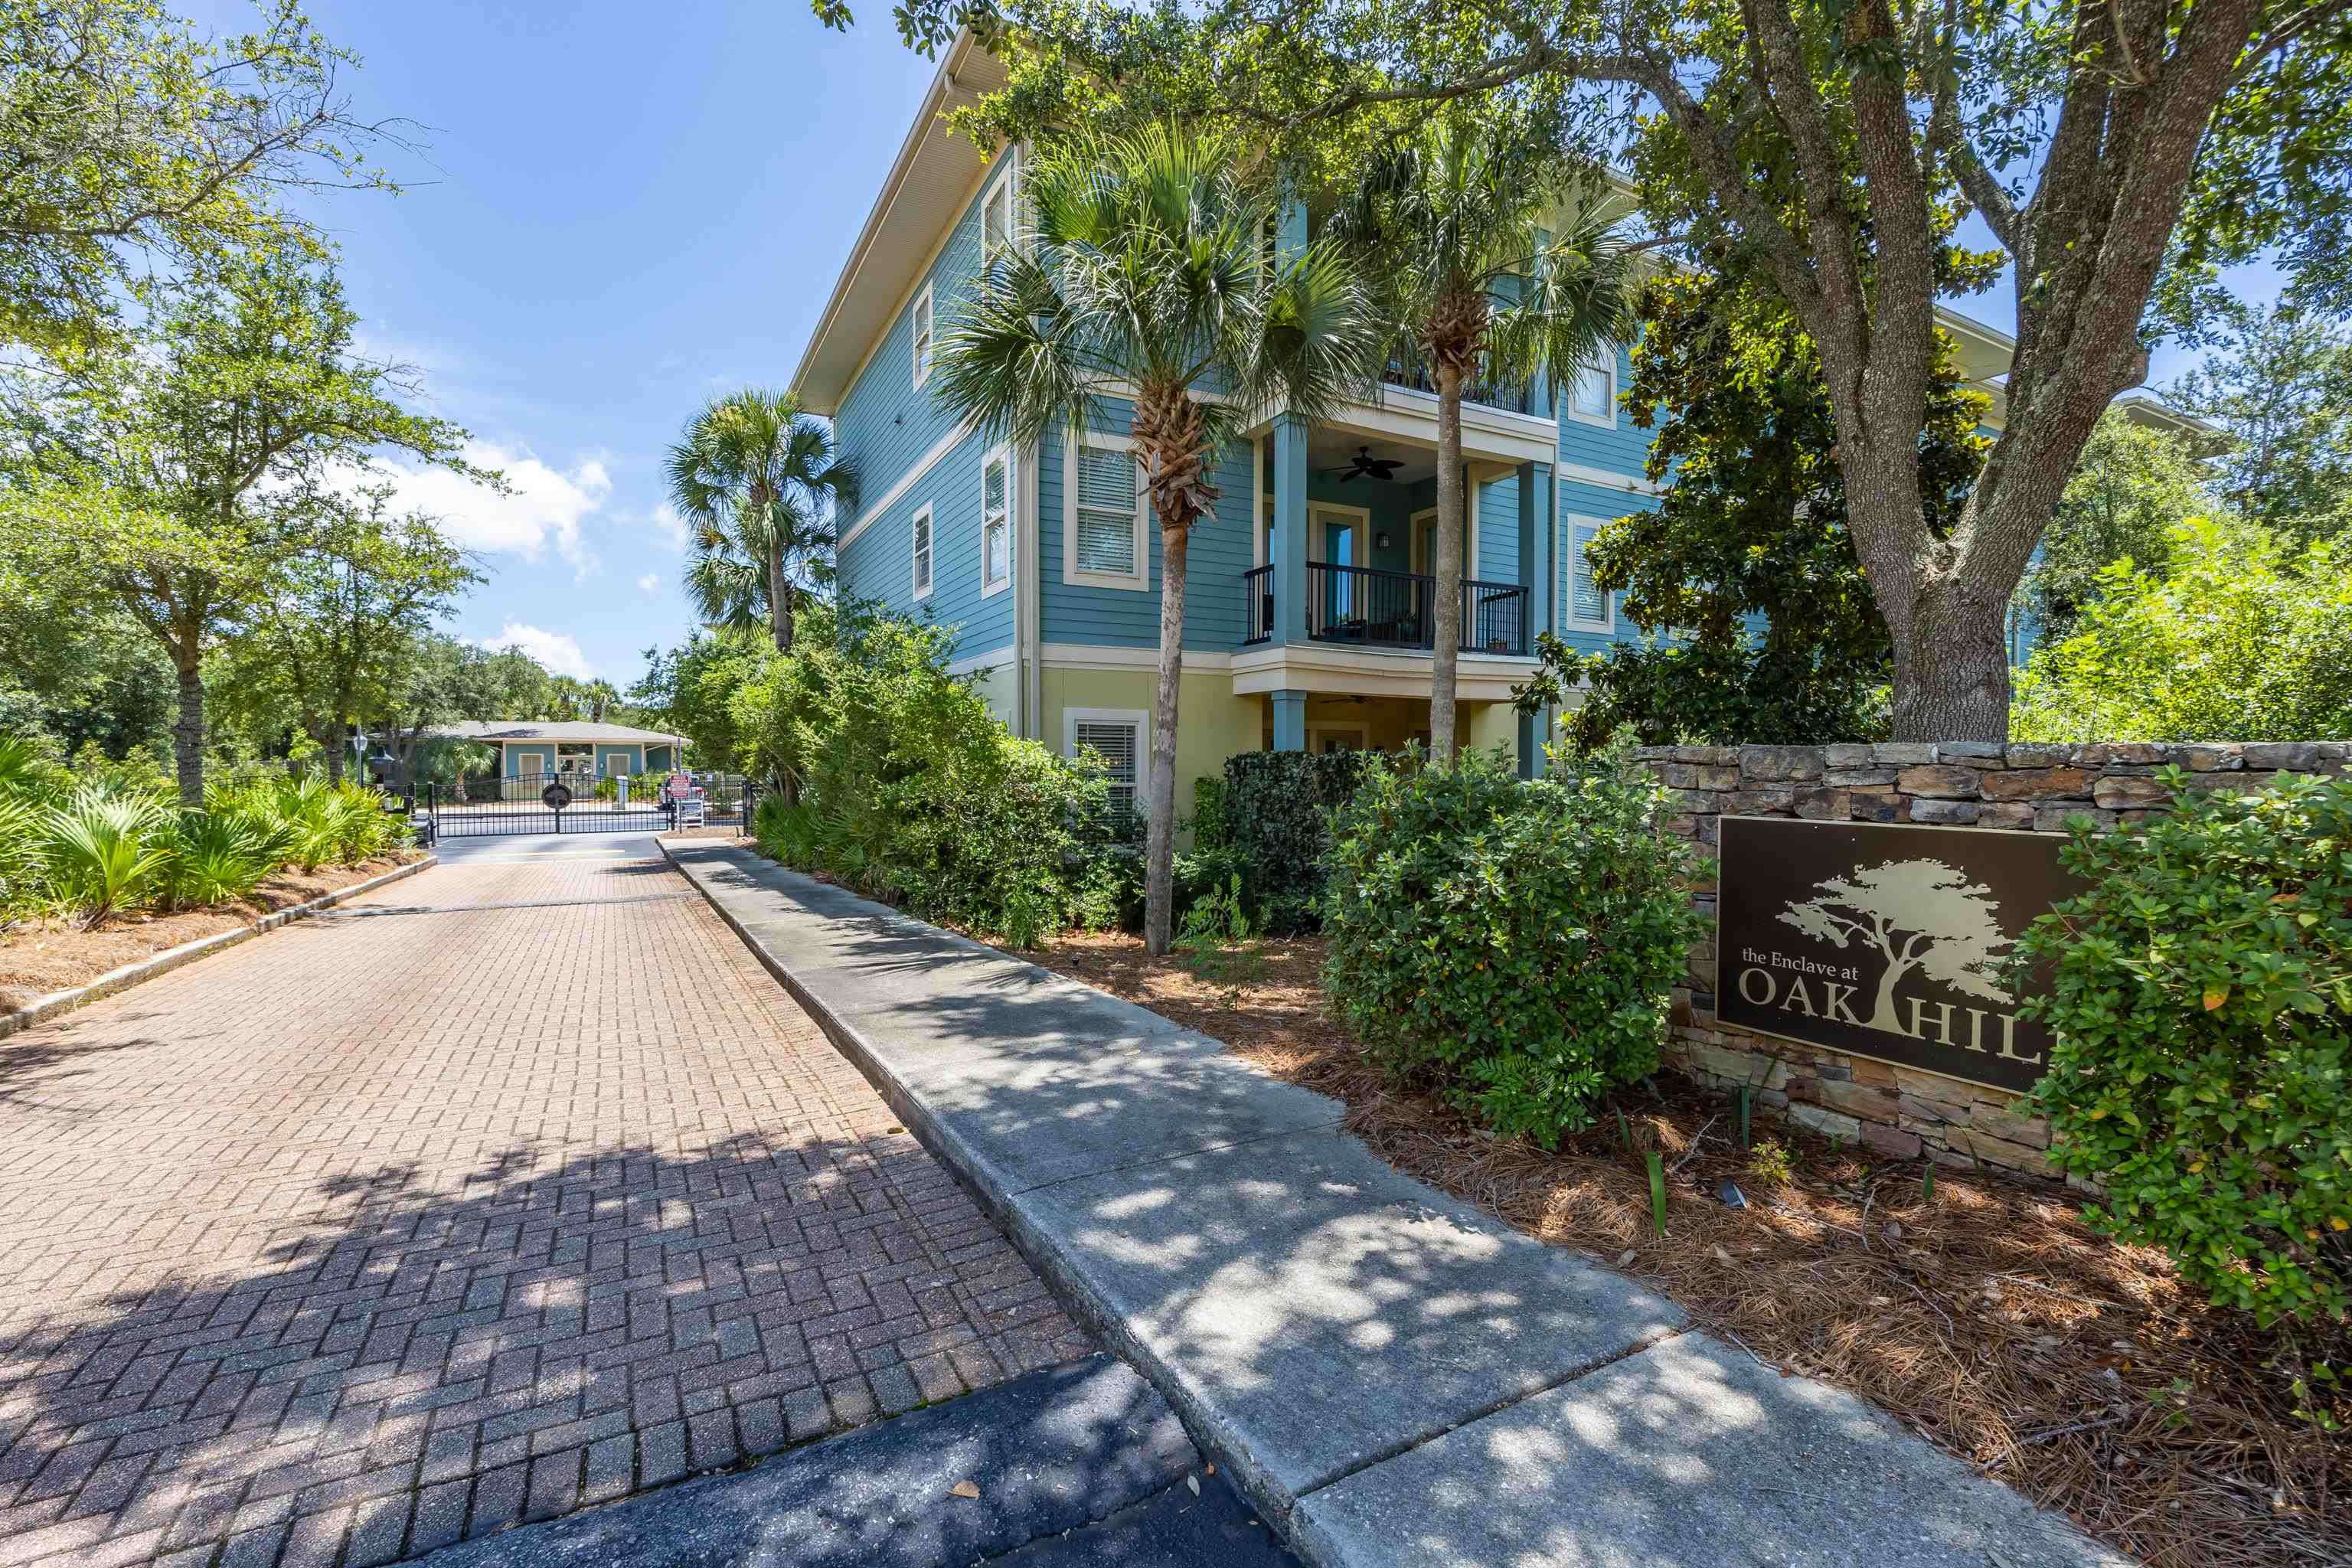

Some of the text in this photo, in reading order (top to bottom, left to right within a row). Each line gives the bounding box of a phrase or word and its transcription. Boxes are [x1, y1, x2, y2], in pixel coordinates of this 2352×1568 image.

[1743, 947, 1859, 981] the Enclave at
[1739, 968, 2090, 1074] OAK HIL
